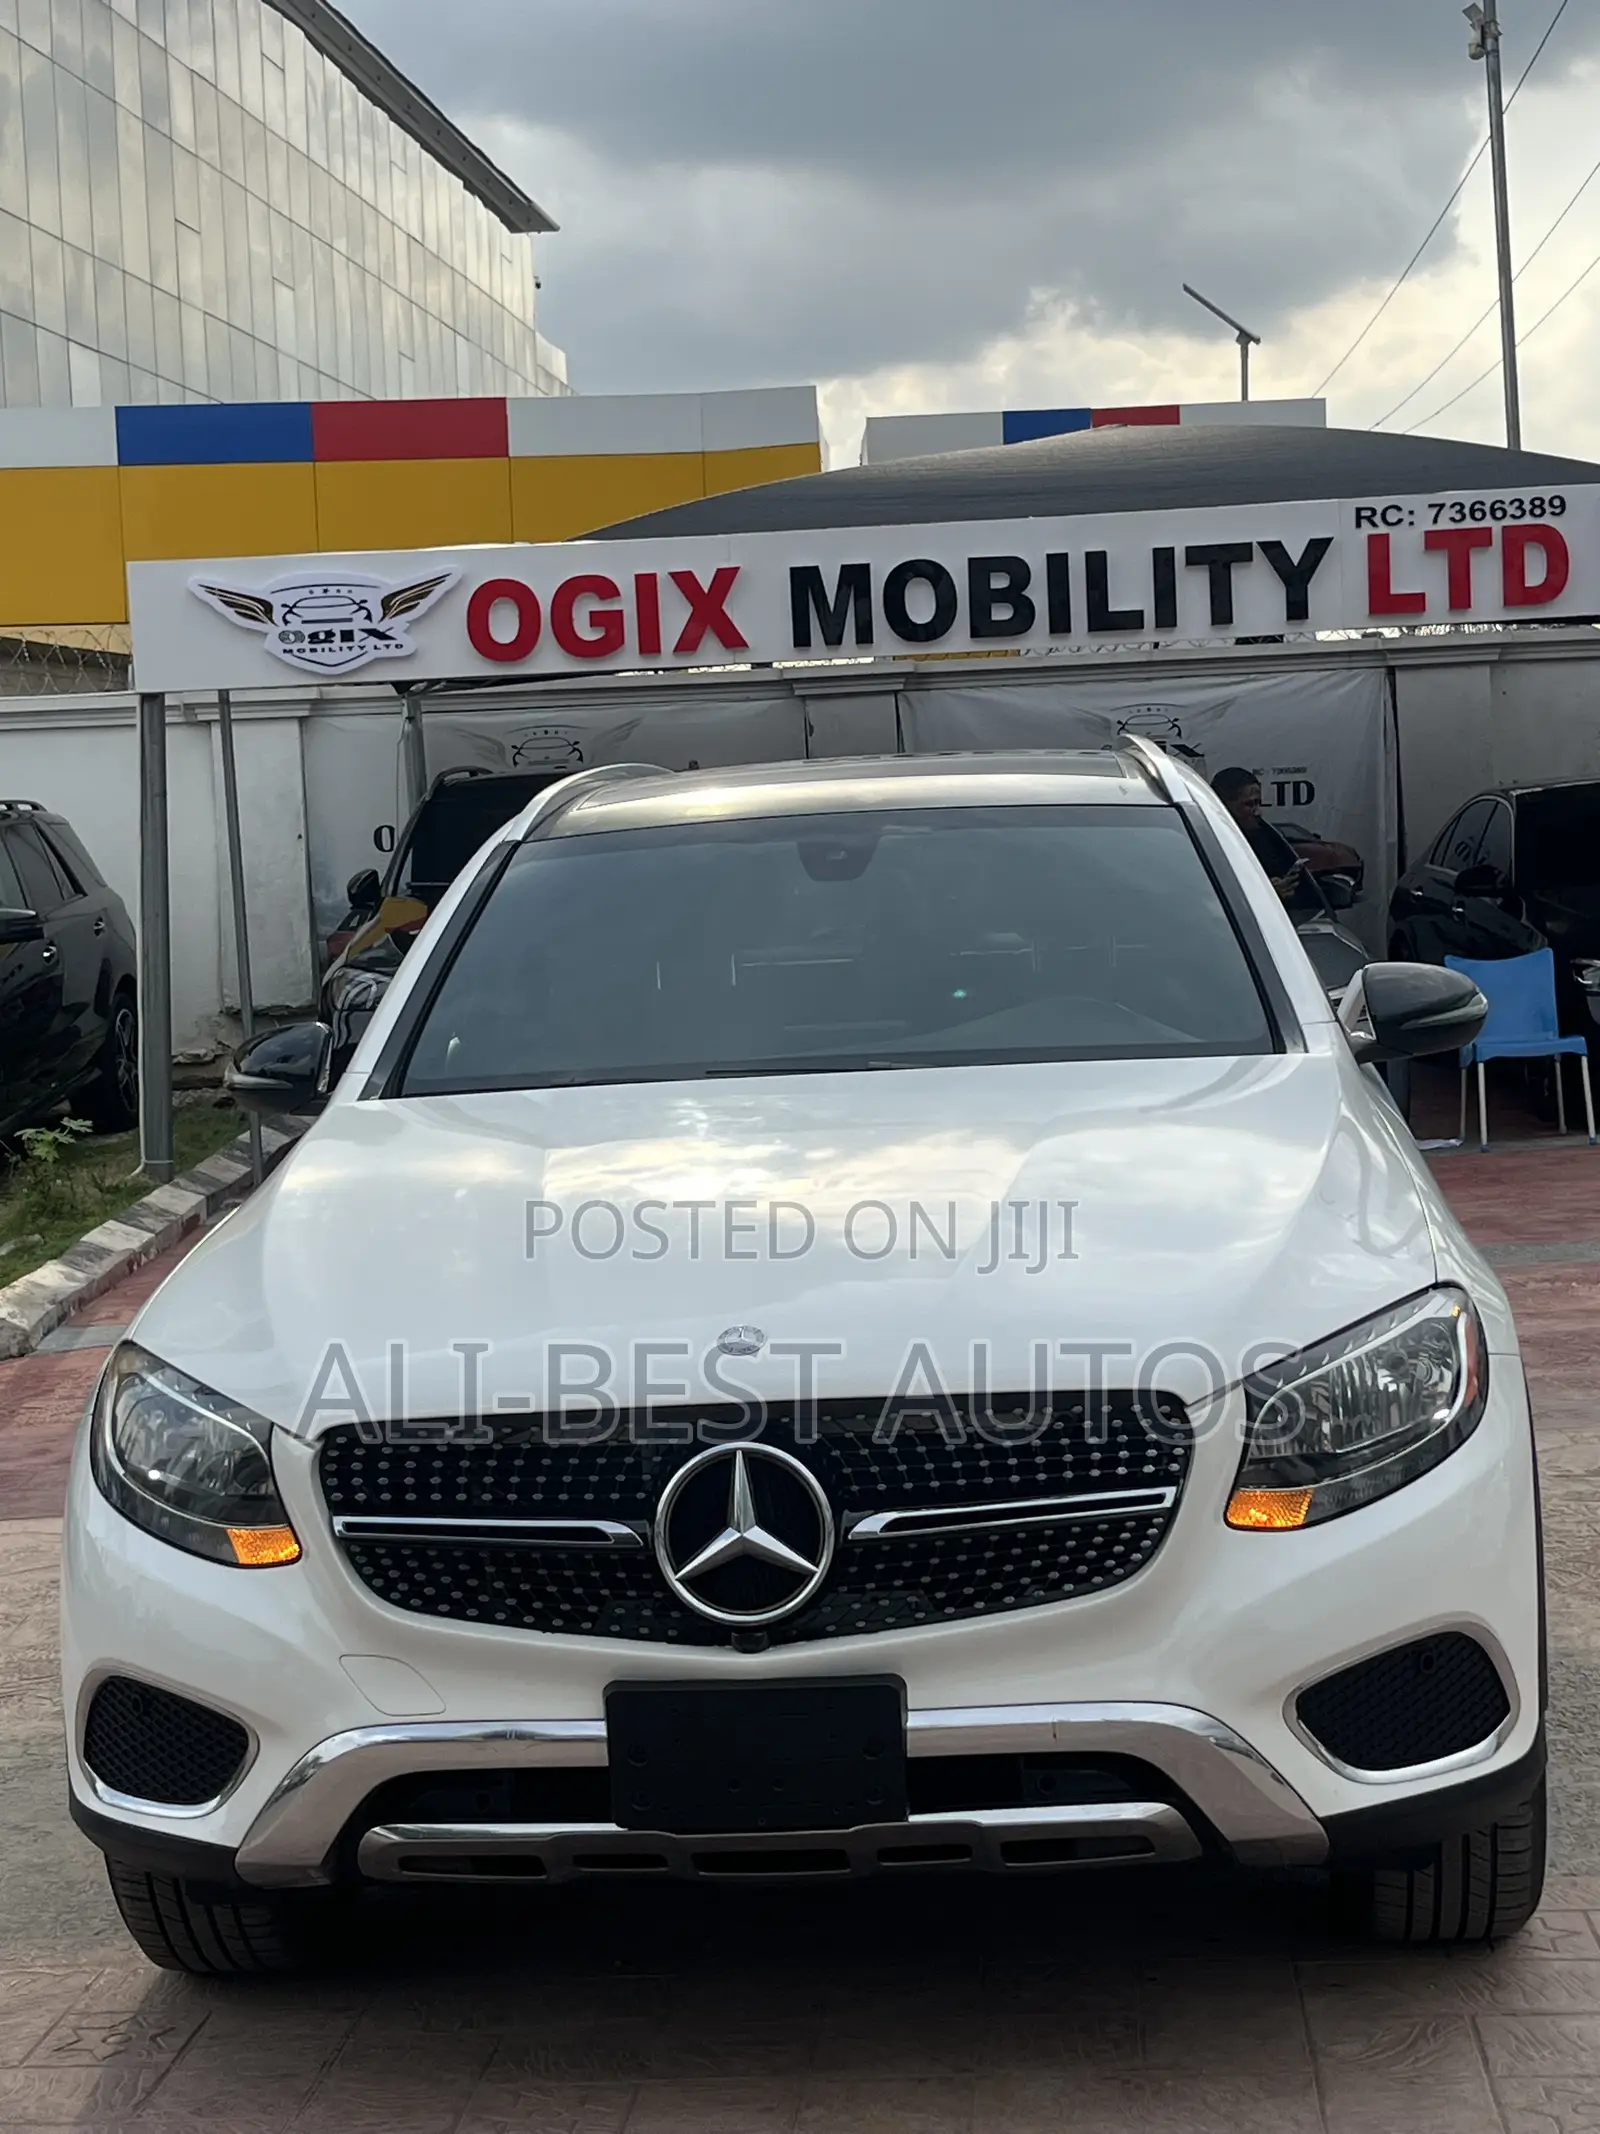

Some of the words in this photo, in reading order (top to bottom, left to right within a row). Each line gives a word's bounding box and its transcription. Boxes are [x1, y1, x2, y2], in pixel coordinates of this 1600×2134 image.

[1355, 504, 1416, 529] RC:
[1428, 494, 1567, 525] 7366389
[466, 566, 750, 663] OGIX
[788, 536, 1334, 649] MOBILITY
[1367, 523, 1570, 615] LTD
[282, 644, 367, 655] MOBILITY
[373, 643, 404, 651] LTD
